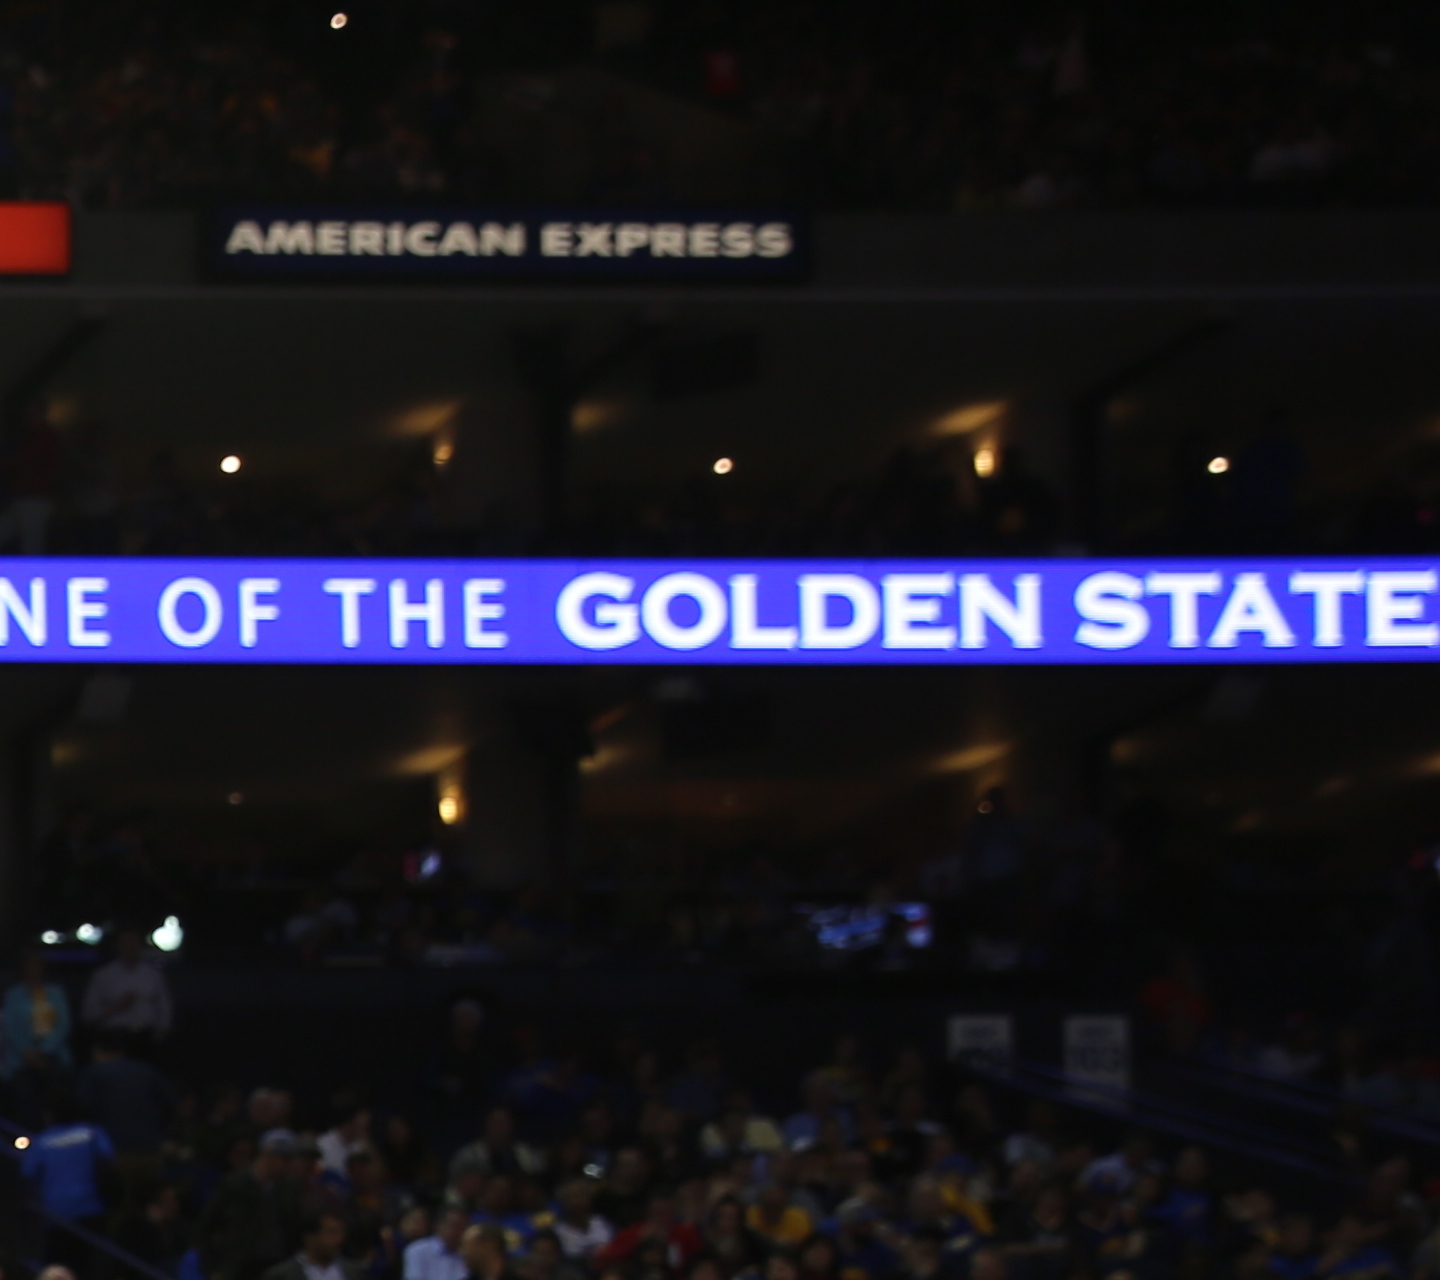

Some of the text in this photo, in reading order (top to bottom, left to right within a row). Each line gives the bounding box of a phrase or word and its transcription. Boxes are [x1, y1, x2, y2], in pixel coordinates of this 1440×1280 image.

[227, 222, 790, 258] AMERICAN EXPRESS
[159, 577, 280, 647] OF
[324, 578, 507, 648] THE
[557, 572, 1042, 649] GOLDEN
[1075, 570, 1440, 649] STATE
